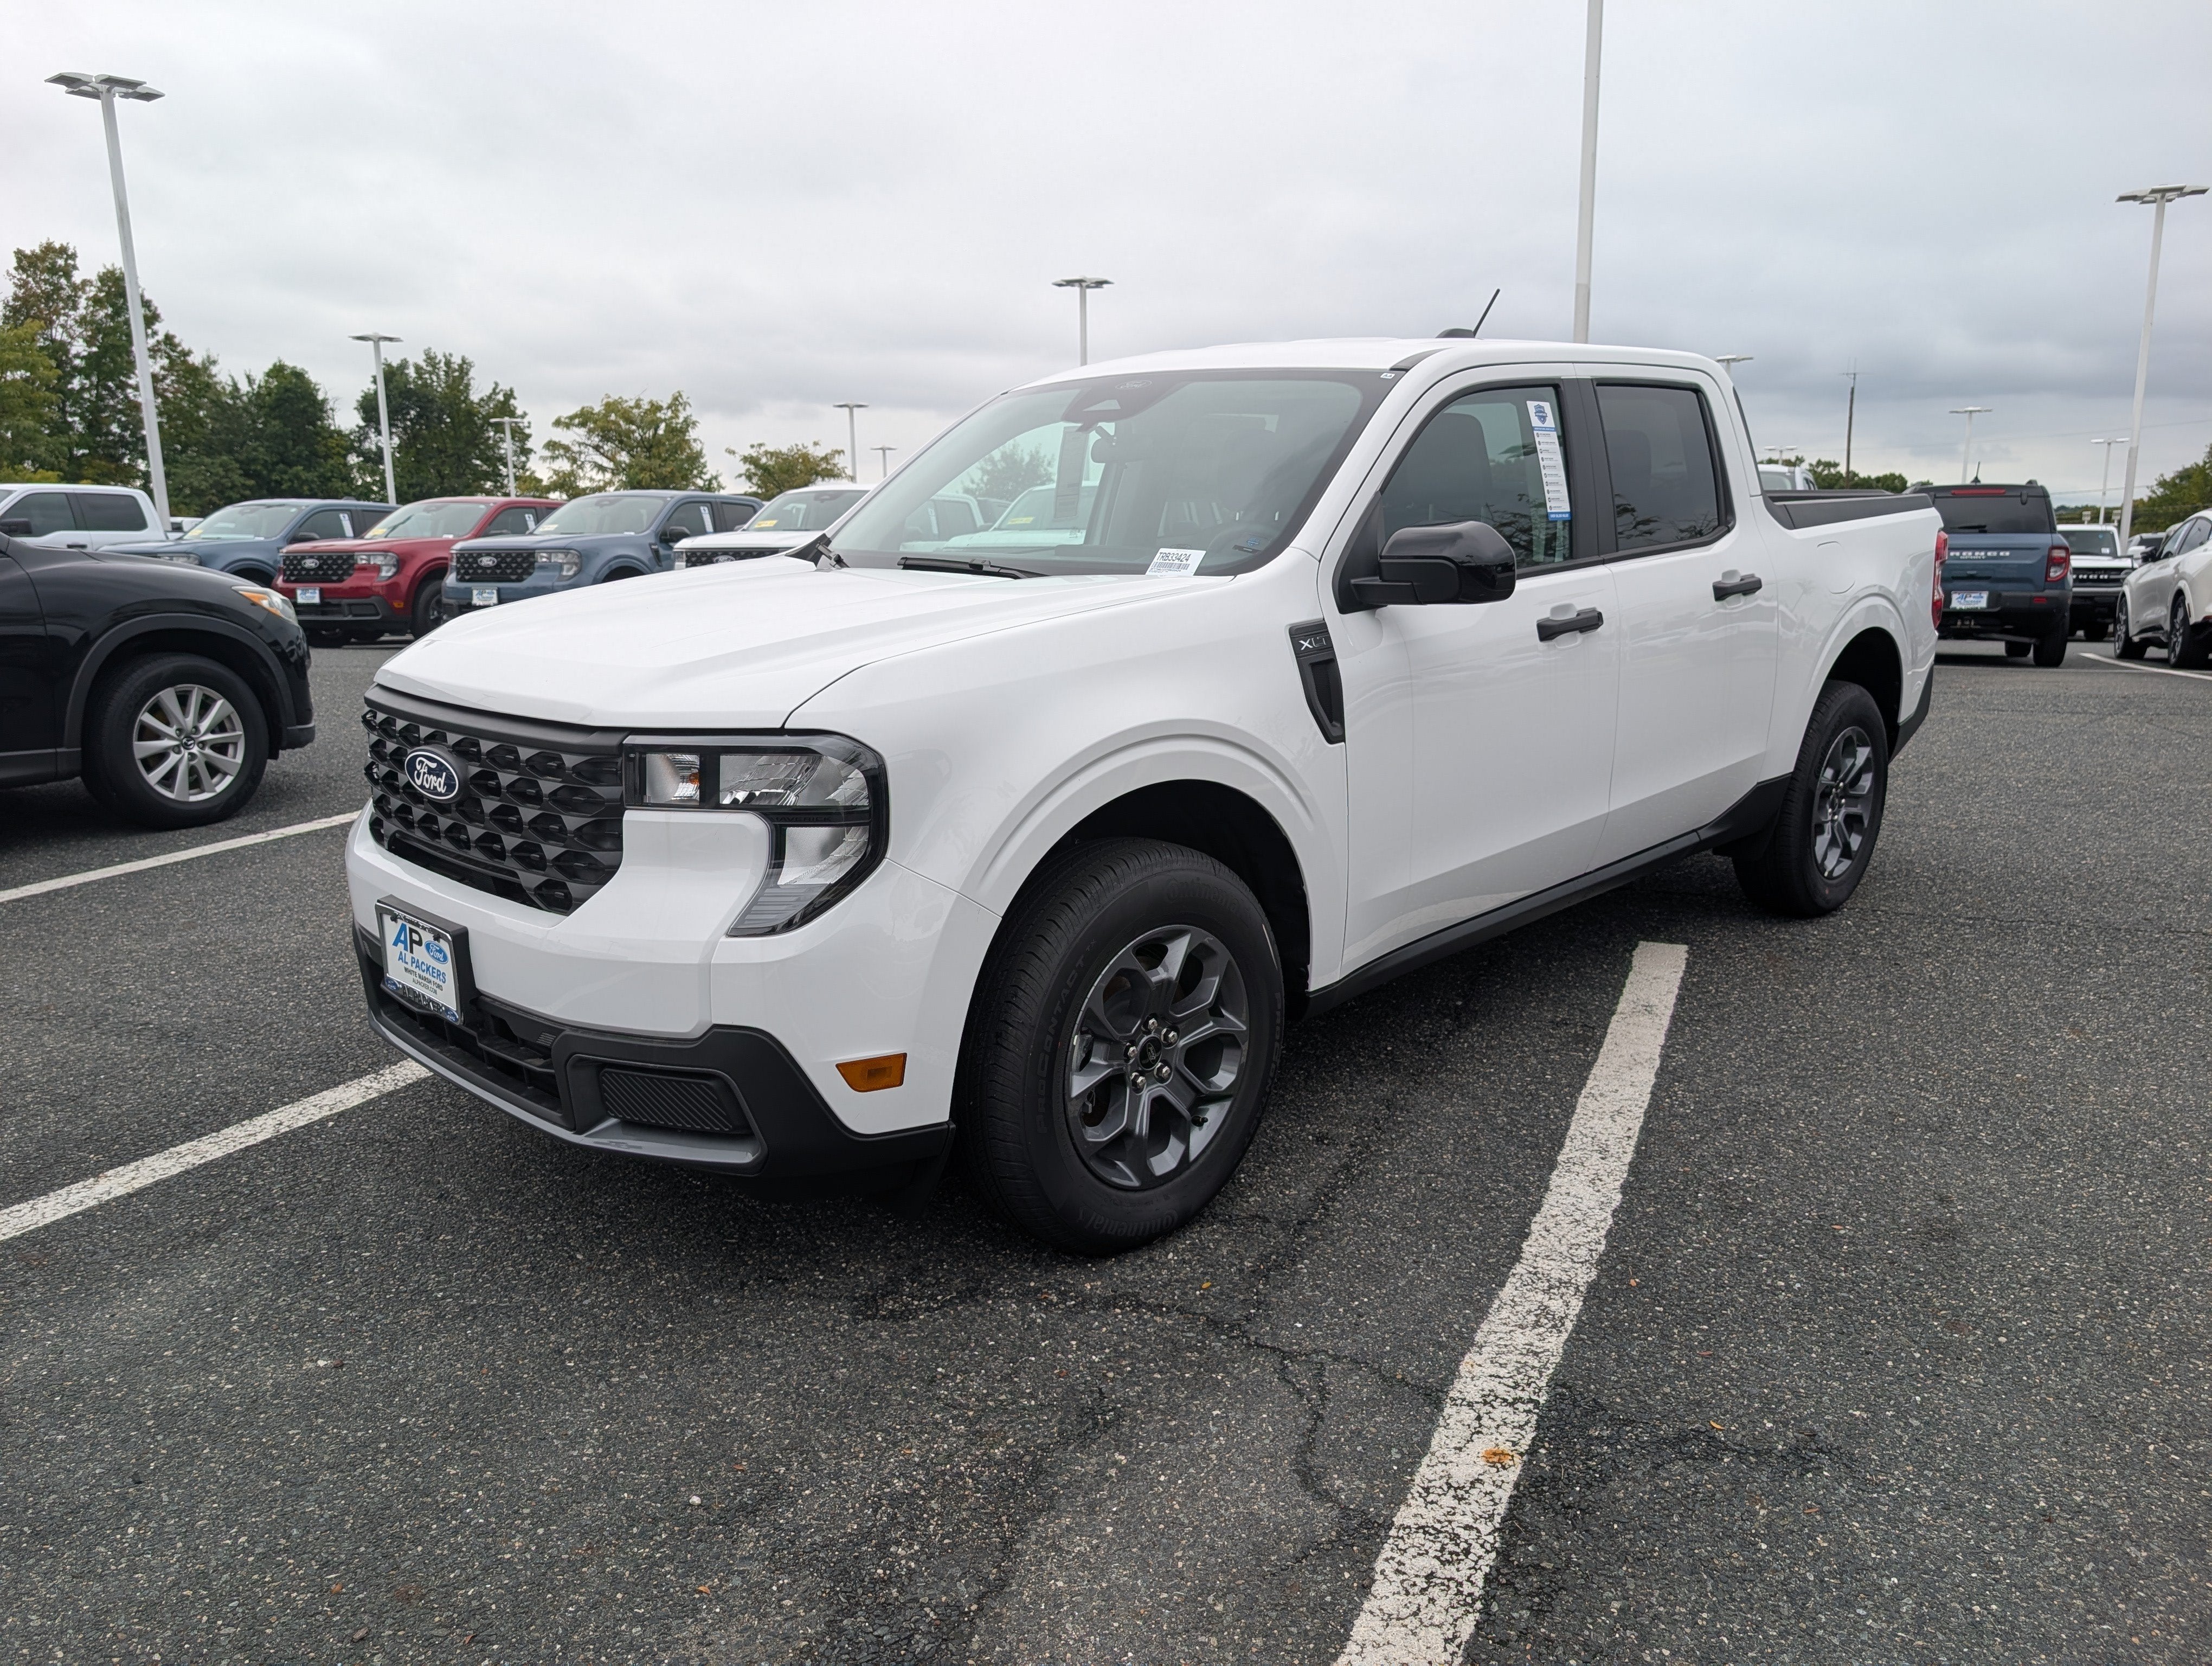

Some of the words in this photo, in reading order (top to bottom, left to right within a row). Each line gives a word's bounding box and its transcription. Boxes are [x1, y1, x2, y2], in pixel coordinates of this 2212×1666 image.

[1156, 552, 1192, 562] TRB33424
[1299, 635, 1330, 650] XLT
[414, 757, 447, 793] Ford
[392, 922, 423, 954] AP
[429, 943, 444, 961] Ford
[398, 950, 409, 965] AL
[410, 958, 446, 984] PACKERS
[404, 966, 419, 979] WHITE
[432, 979, 443, 992] FORD
